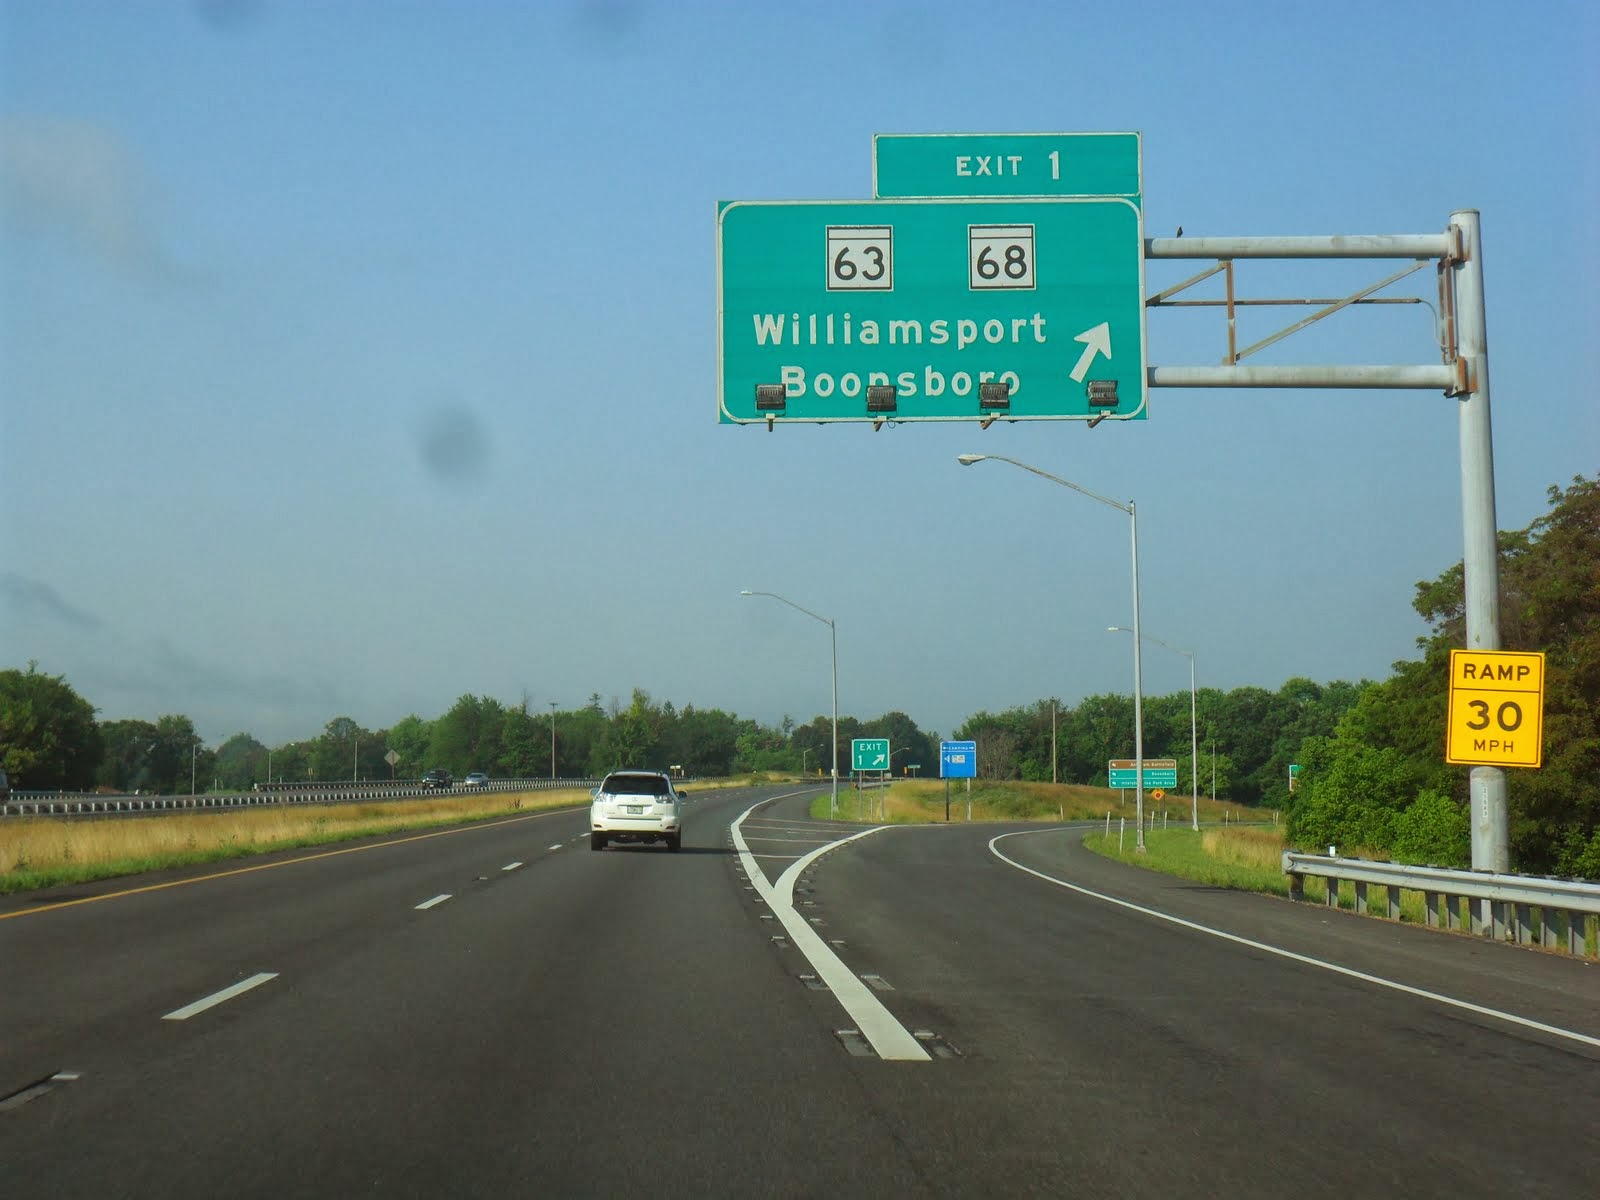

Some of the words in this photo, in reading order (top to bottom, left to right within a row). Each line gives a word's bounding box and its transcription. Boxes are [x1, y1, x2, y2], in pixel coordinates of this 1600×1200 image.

[956, 155, 1022, 177] EXIT
[1048, 151, 1060, 180] 1
[833, 246, 886, 281] 63
[976, 244, 1028, 280] 68
[753, 311, 1047, 350] Williamsport
[1463, 663, 1531, 682] RAMP
[1466, 700, 1523, 732] 30
[858, 754, 862, 765] 1
[860, 743, 882, 751] EXIT
[1473, 739, 1515, 753] MPH
